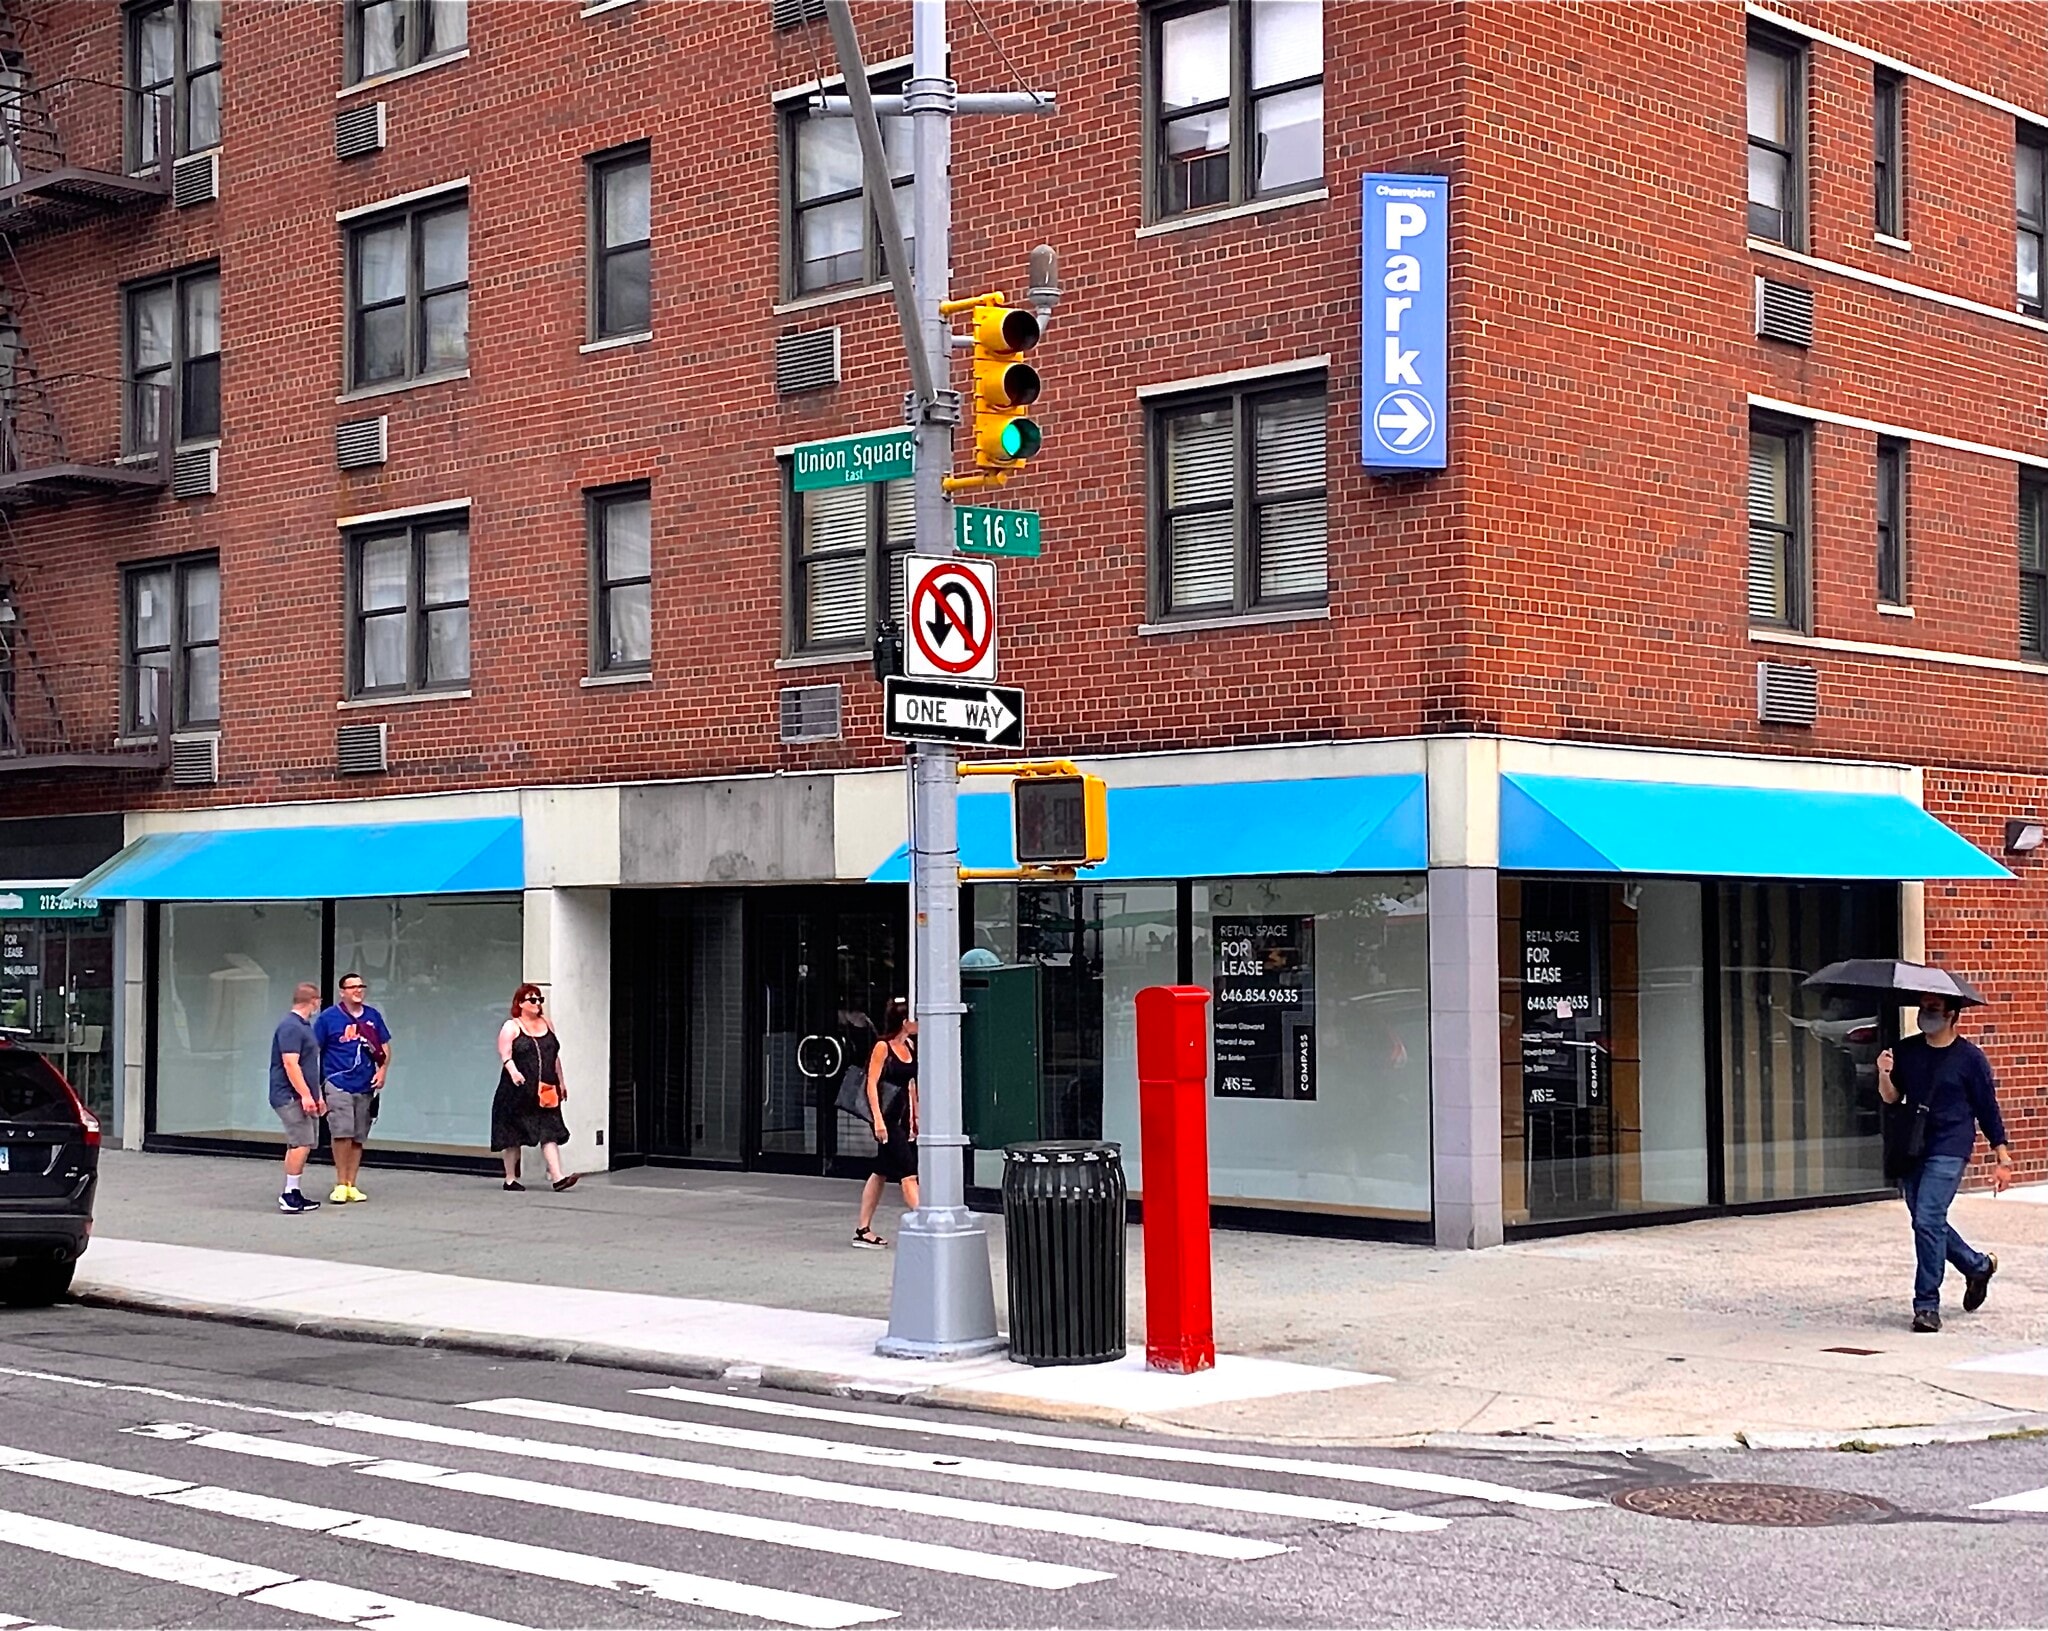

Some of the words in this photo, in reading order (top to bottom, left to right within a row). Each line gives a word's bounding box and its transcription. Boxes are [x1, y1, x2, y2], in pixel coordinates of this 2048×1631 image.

[1376, 185, 1436, 199] Champion
[1384, 202, 1427, 385] Park
[798, 448, 846, 474] Union
[853, 440, 912, 470] Square
[845, 469, 864, 482] East
[963, 512, 974, 545] E
[983, 514, 1006, 548] 16
[1016, 517, 1029, 538] St
[906, 698, 947, 723] ONE
[965, 703, 1004, 729] WAY
[1220, 925, 1253, 937] RETAIL
[1256, 925, 1288, 937] SPACE
[1526, 930, 1553, 942] RETAIL
[1555, 930, 1580, 942] SPACE
[1221, 941, 1249, 957] FOR
[1526, 947, 1550, 963] FOR
[1221, 960, 1263, 976] LEASE
[1526, 967, 1562, 983] LEASE
[1221, 988, 1299, 1003] 646.854.9635
[1300, 1034, 1309, 1091] COMPASS
[1590, 1042, 1598, 1098] COMPAS
